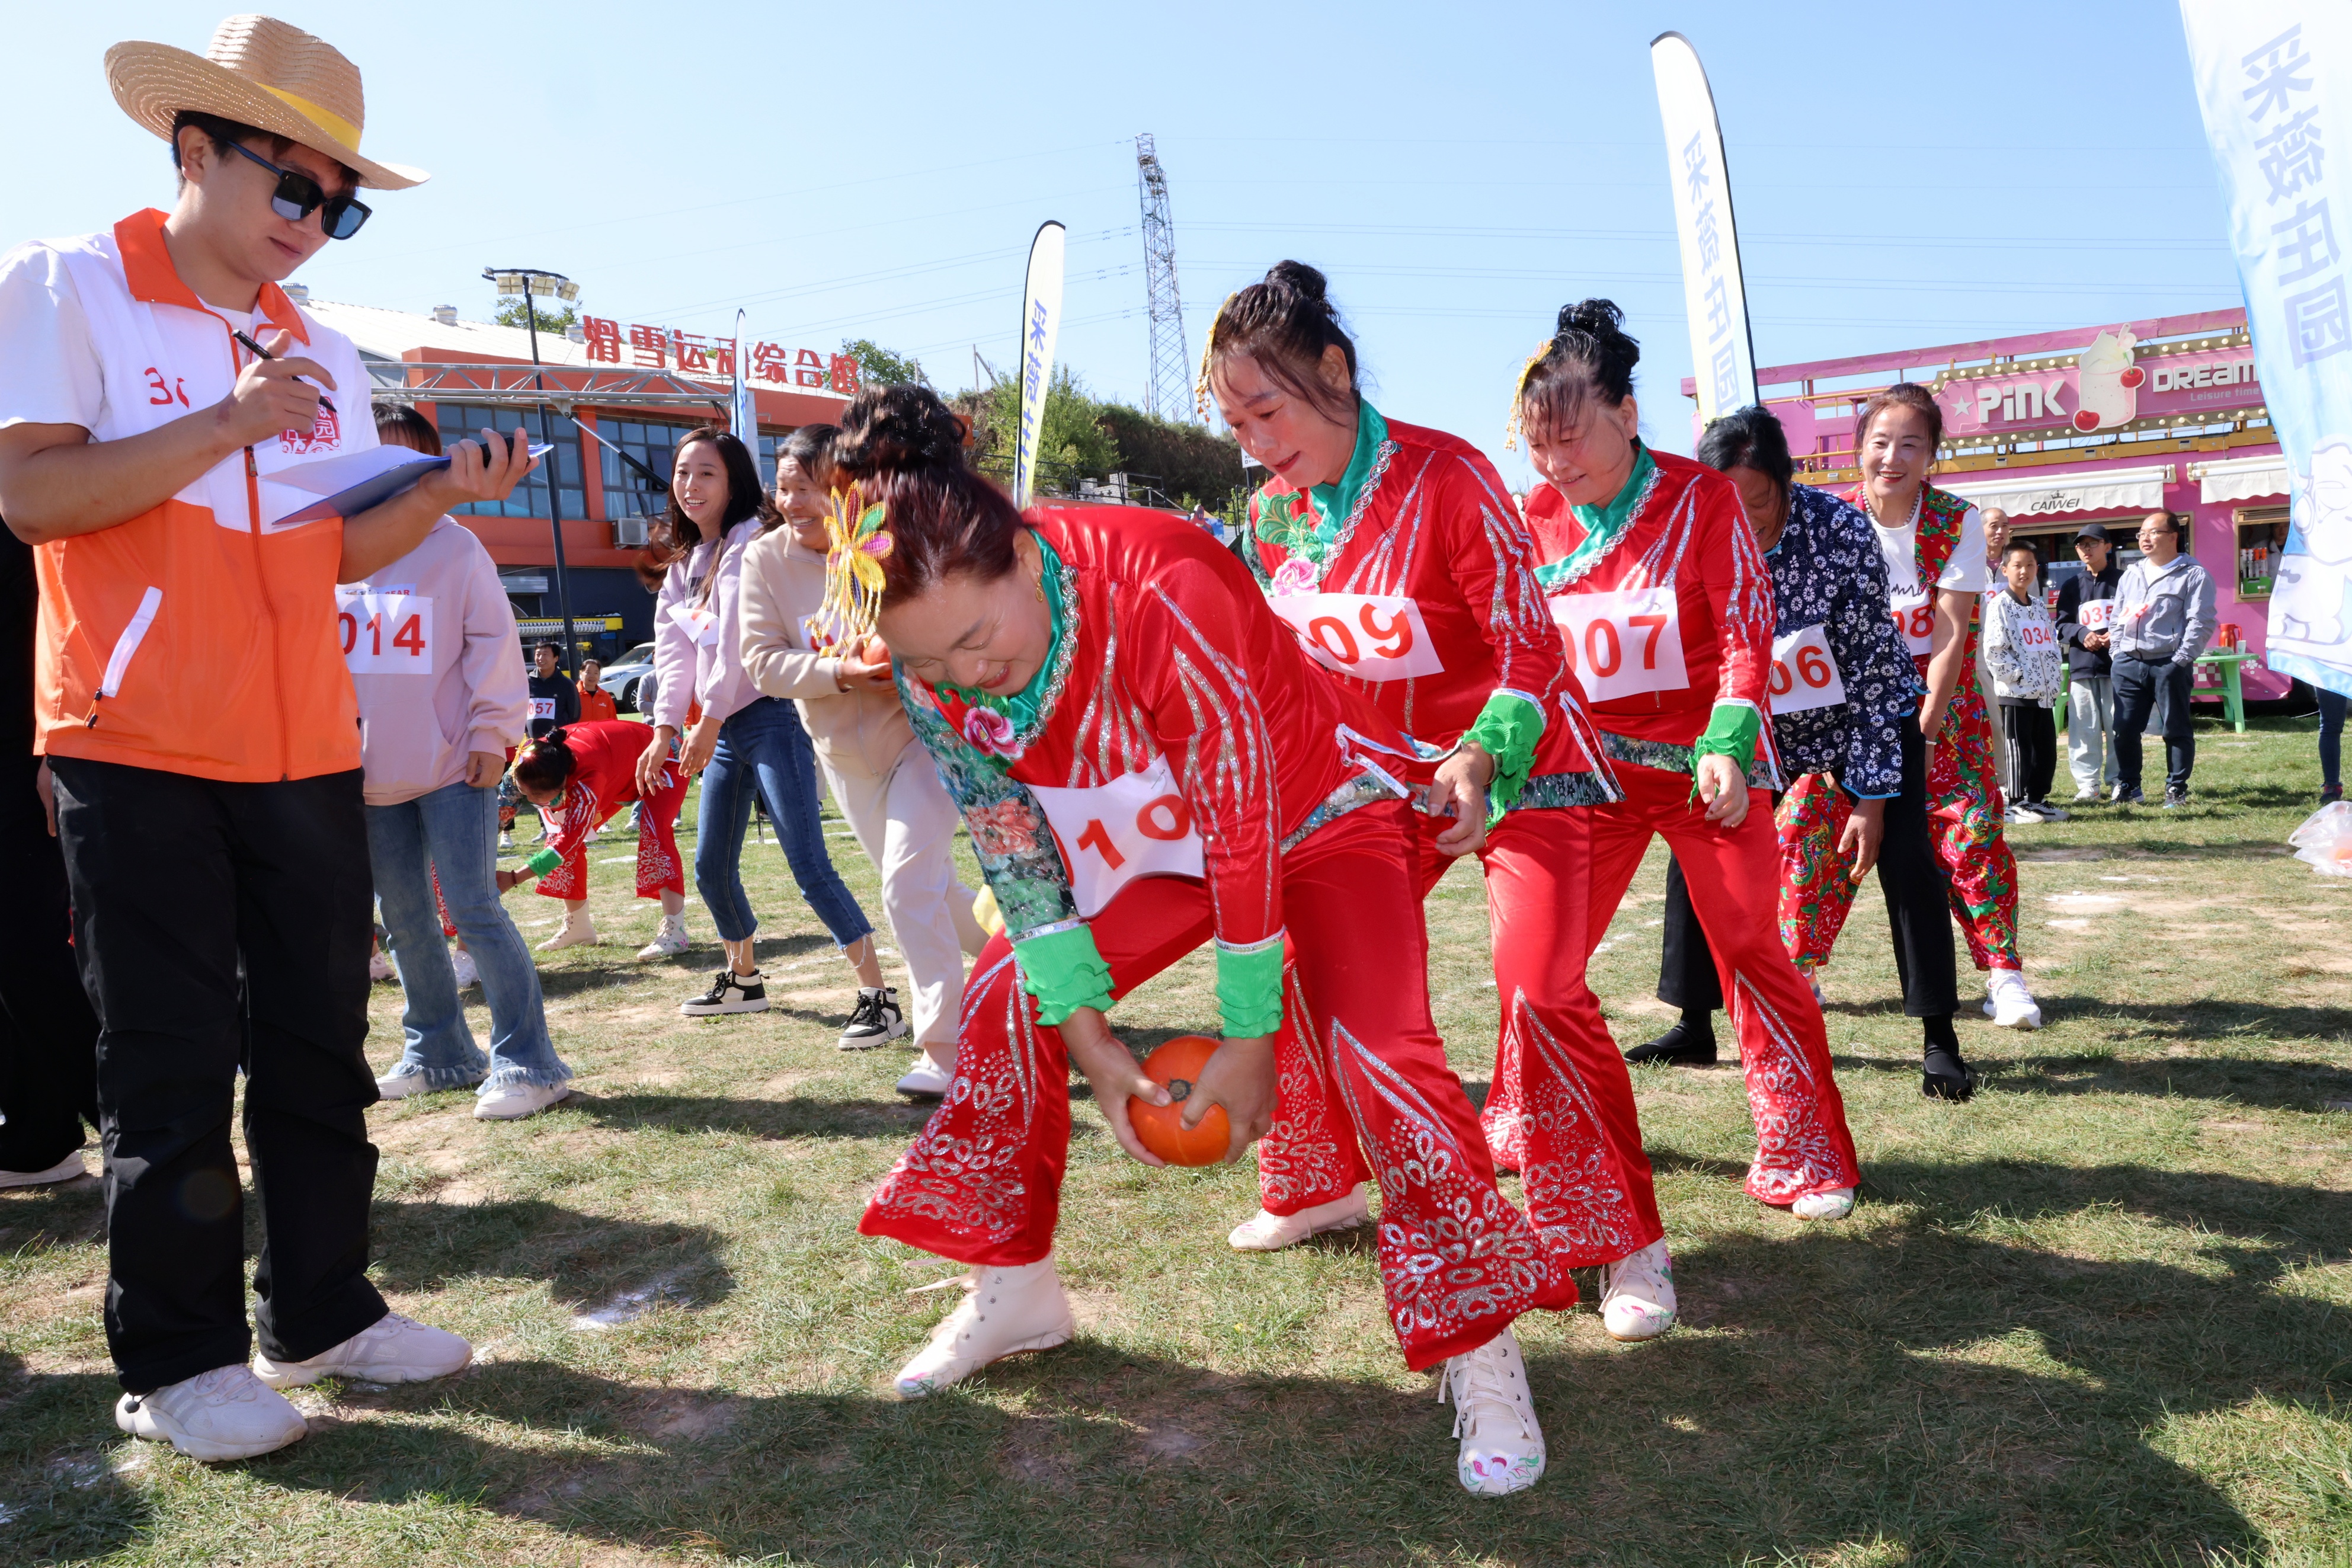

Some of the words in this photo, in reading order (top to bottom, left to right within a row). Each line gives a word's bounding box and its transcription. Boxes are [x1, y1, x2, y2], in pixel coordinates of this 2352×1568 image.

[2190, 391, 2231, 401] Leisure
[2235, 387, 2260, 397] time
[2031, 498, 2080, 511] CAIWEI
[2023, 626, 2052, 645] 034
[529, 703, 553, 715] 057
